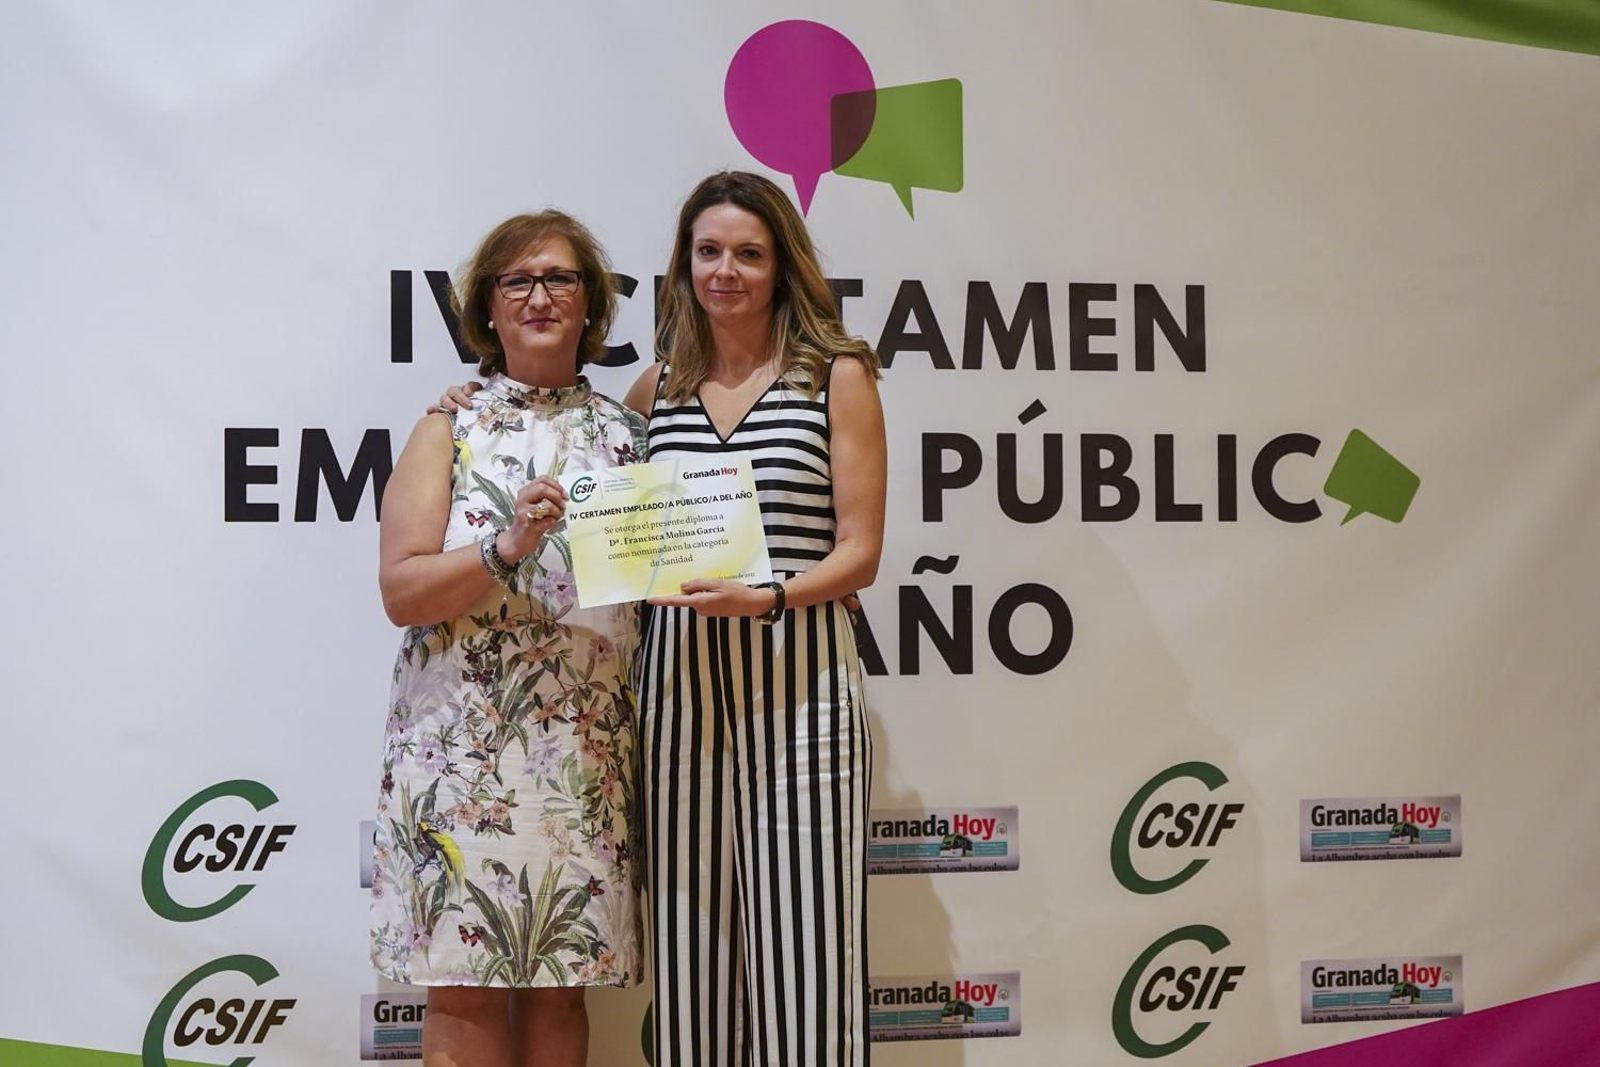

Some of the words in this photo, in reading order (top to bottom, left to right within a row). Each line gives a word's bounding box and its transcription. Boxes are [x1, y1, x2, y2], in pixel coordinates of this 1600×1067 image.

[683, 469, 720, 480] Granada
[720, 467, 738, 476] Hoy
[575, 483, 597, 495] CSIF
[569, 513, 578, 521] IV
[579, 507, 622, 519] CERTAMEN
[623, 501, 674, 513] EMPLEADO/A
[676, 495, 719, 507] PÚBLICO/A
[720, 493, 733, 502] DEL
[735, 490, 753, 499] AÑO
[604, 526, 614, 535] Se
[614, 524, 641, 533] otorga
[641, 521, 650, 529] el
[650, 518, 684, 530] presente
[685, 514, 718, 525] diploma
[624, 534, 664, 545] Francisca
[665, 529, 696, 540] Molina
[696, 526, 725, 535] García
[608, 551, 630, 560] como
[631, 544, 672, 557] nominada
[684, 542, 692, 550] la
[650, 559, 660, 567] de
[660, 554, 694, 566] Sanidad
[871, 814, 949, 838] ranada
[953, 814, 996, 840] Hoy
[1137, 802, 1245, 849] CSIF
[1311, 803, 1398, 827] Granada
[1402, 802, 1441, 828] Hoy
[173, 824, 297, 874] CSIF
[1312, 963, 1398, 988] Granada
[1402, 962, 1442, 988] Hoy
[955, 980, 998, 1006] Hoy
[1139, 966, 1246, 1013] CSIF
[173, 998, 297, 1047] CSIF
[374, 1000, 427, 1023] Gran
